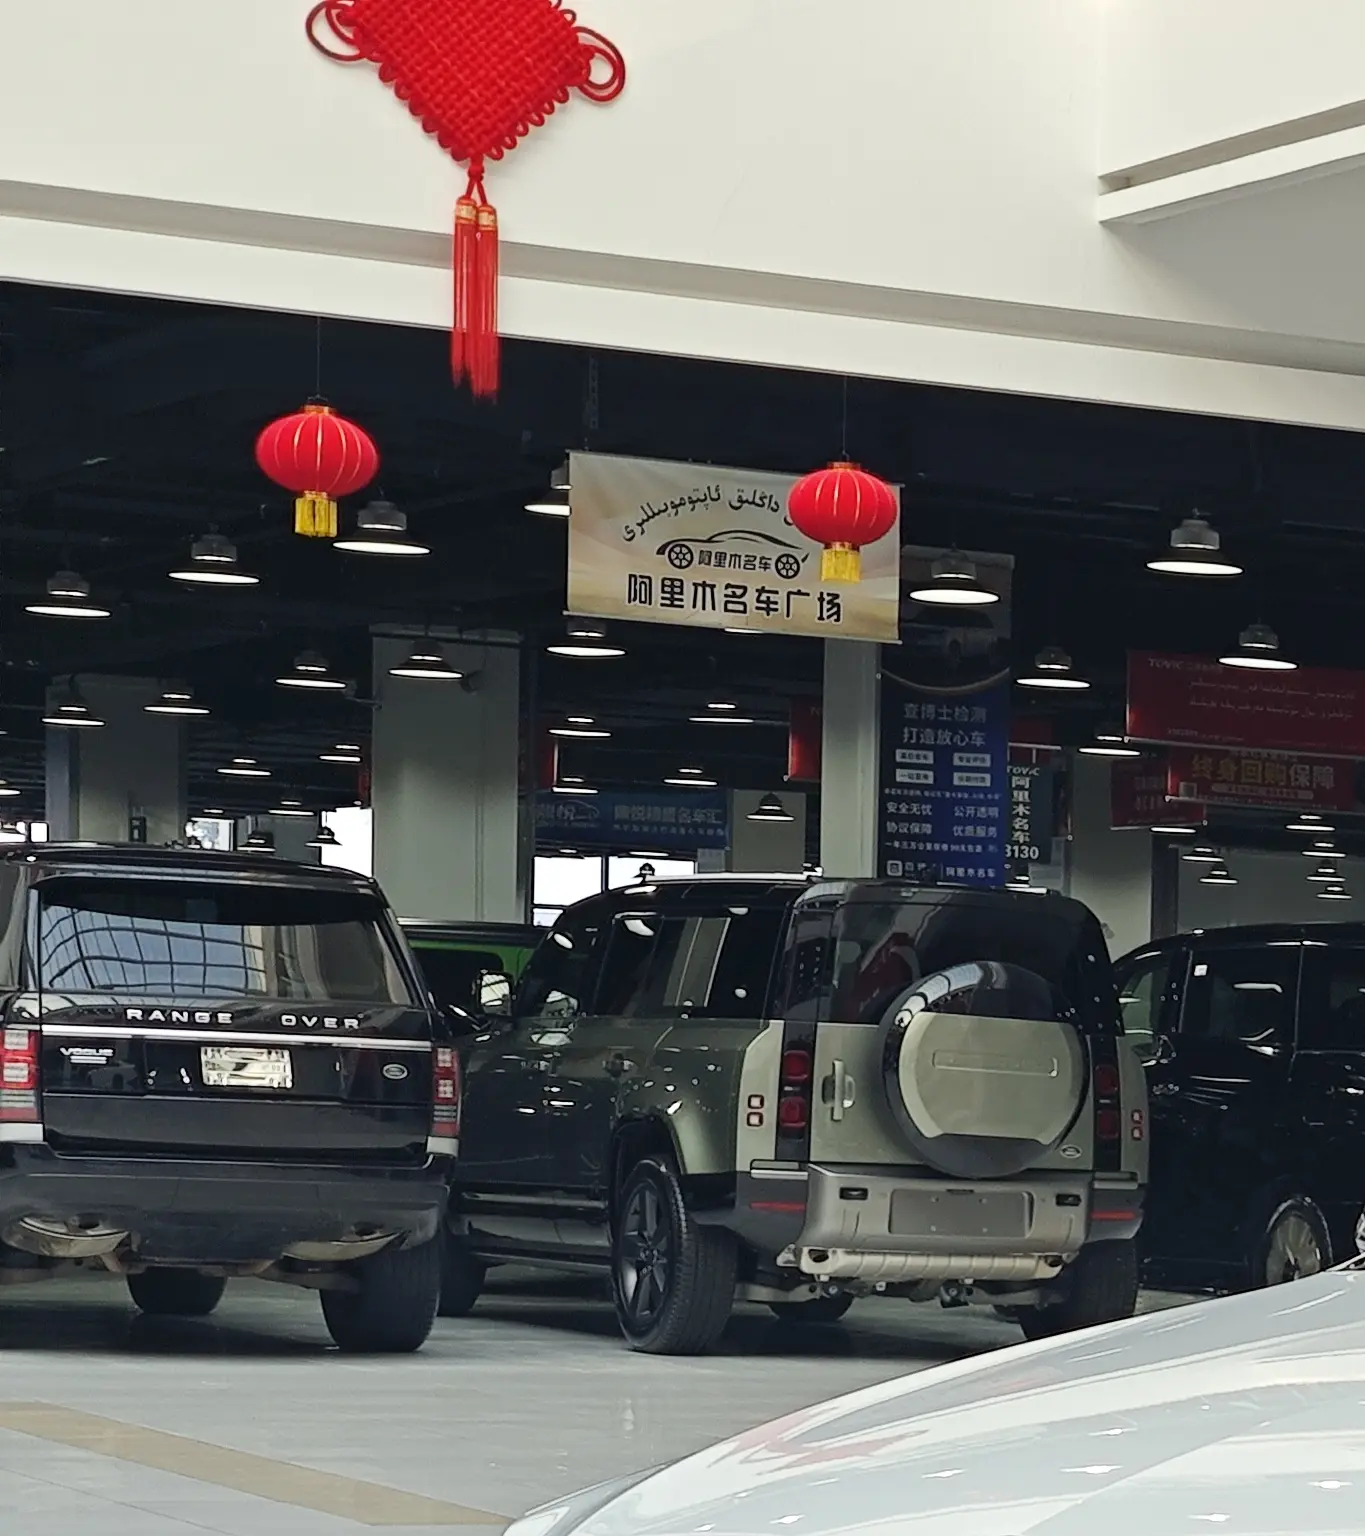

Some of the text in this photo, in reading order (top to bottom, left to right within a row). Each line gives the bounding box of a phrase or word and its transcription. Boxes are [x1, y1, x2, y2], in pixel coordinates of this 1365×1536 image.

[699, 550, 772, 572] 阿里木名车
[627, 573, 842, 623] 阿里木名车广场
[904, 703, 987, 724] 查博士检测
[902, 726, 986, 748] 打造放心车
[1191, 755, 1336, 790] 终身回购保障
[886, 802, 932, 816] 安全无忧
[953, 805, 999, 819] 公开透明
[1011, 776, 1032, 844] 阿里木名车
[126, 1008, 361, 1030] RANGE OVER
